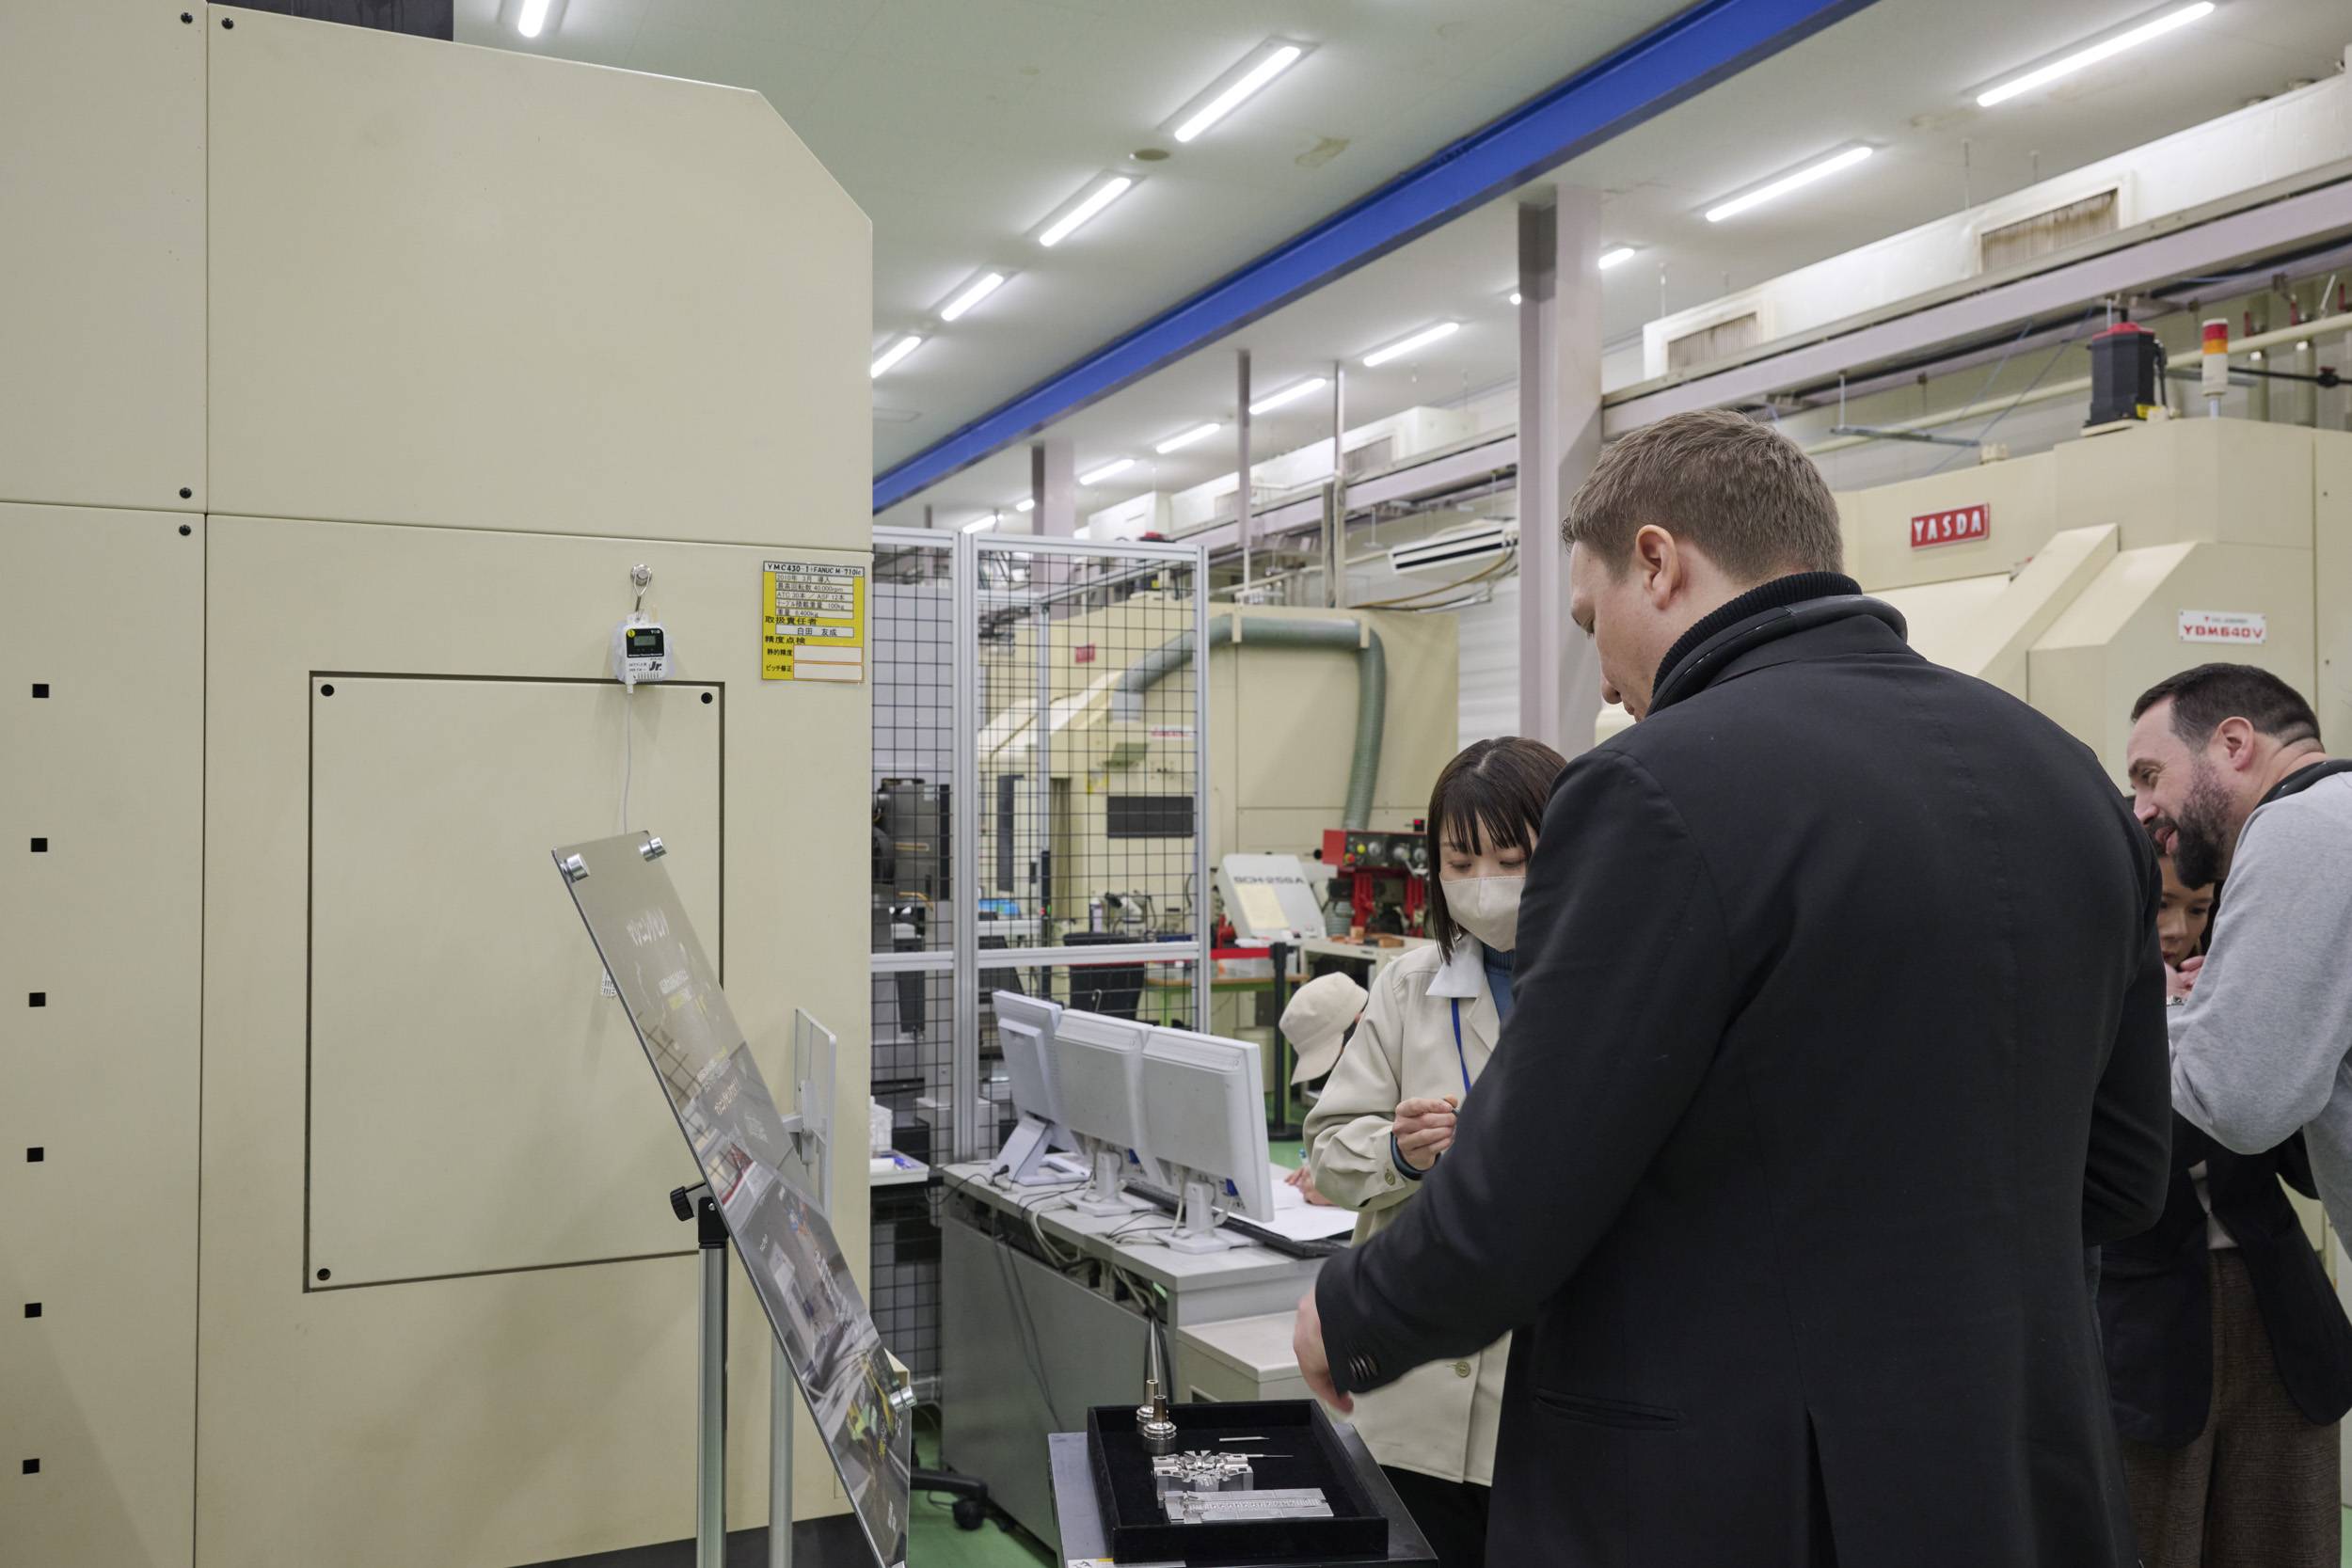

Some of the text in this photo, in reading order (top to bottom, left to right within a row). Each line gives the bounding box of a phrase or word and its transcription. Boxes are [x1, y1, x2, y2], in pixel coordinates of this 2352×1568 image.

[1915, 509, 1982, 543] YASDA
[765, 616, 817, 625] 取扱責任者
[2184, 624, 2264, 639] YBM640V
[765, 636, 805, 644] 精度点検
